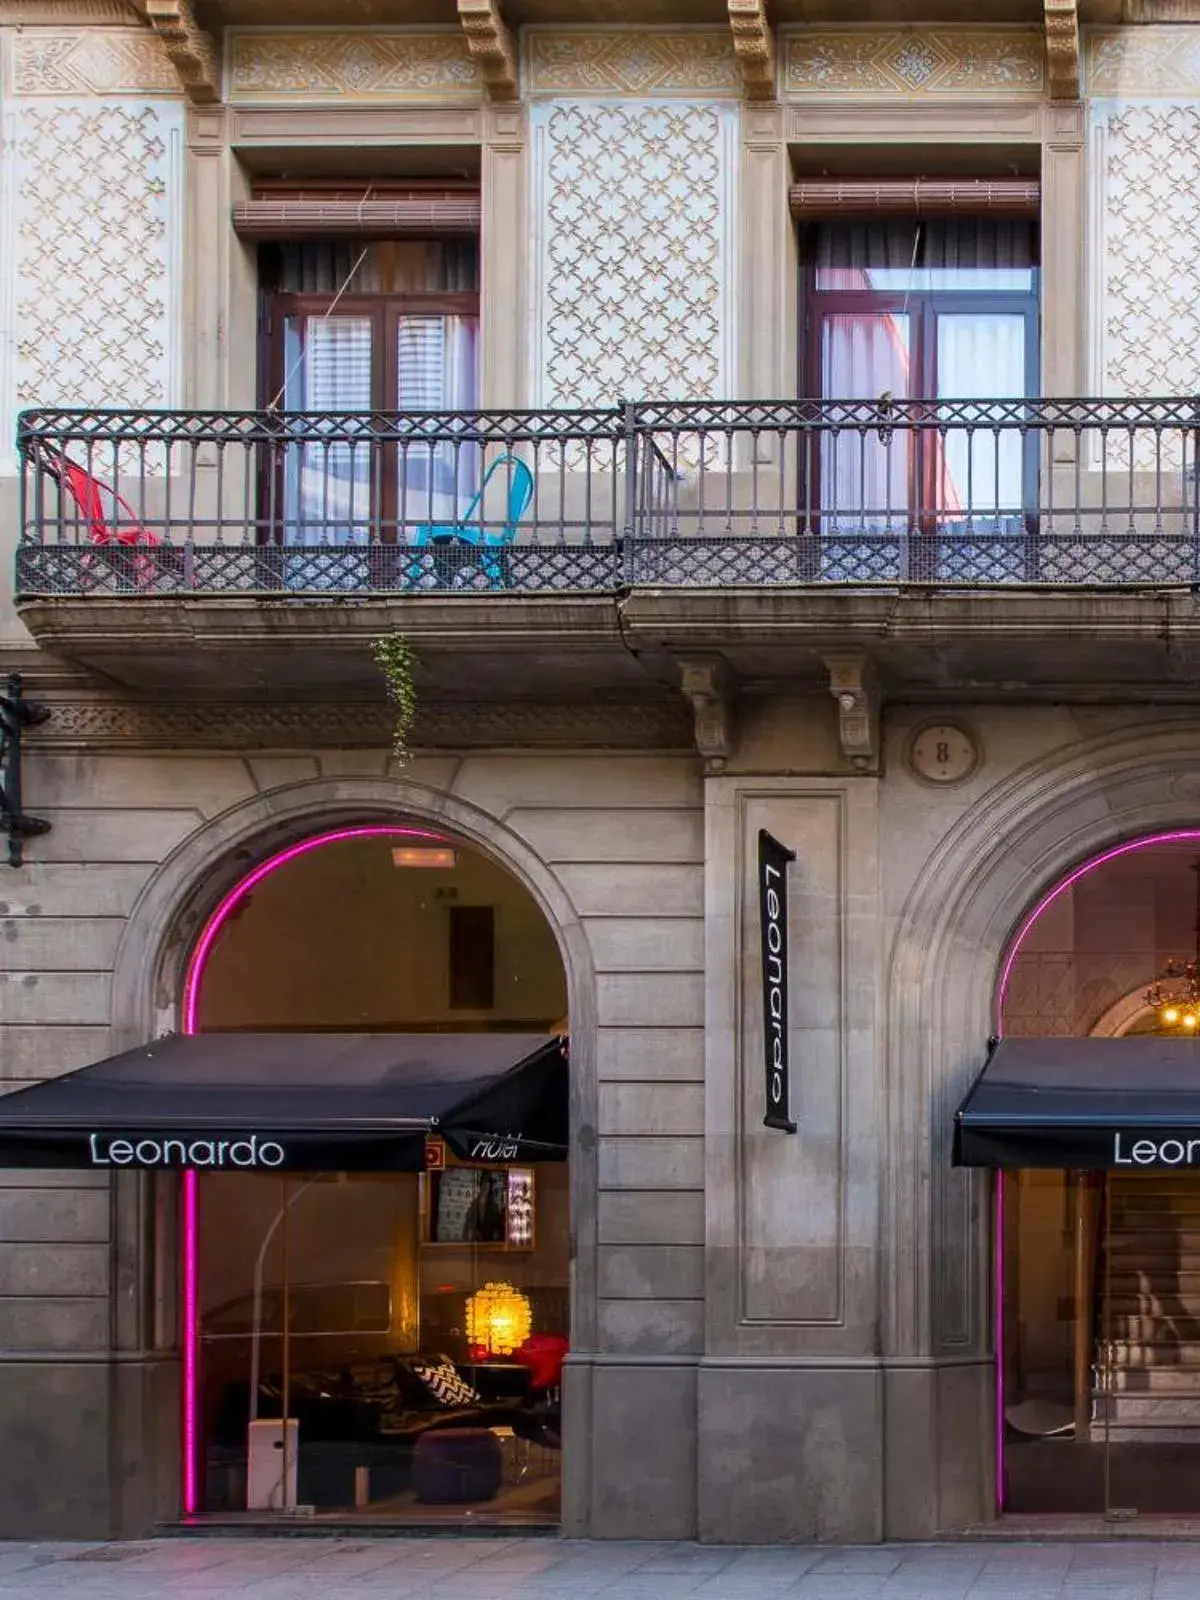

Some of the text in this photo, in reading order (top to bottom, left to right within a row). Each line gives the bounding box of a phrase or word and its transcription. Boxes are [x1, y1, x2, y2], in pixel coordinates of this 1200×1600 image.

[936, 742, 949, 763] 8
[764, 865, 782, 1105] Leonardo
[90, 1133, 285, 1166] Leonardo
